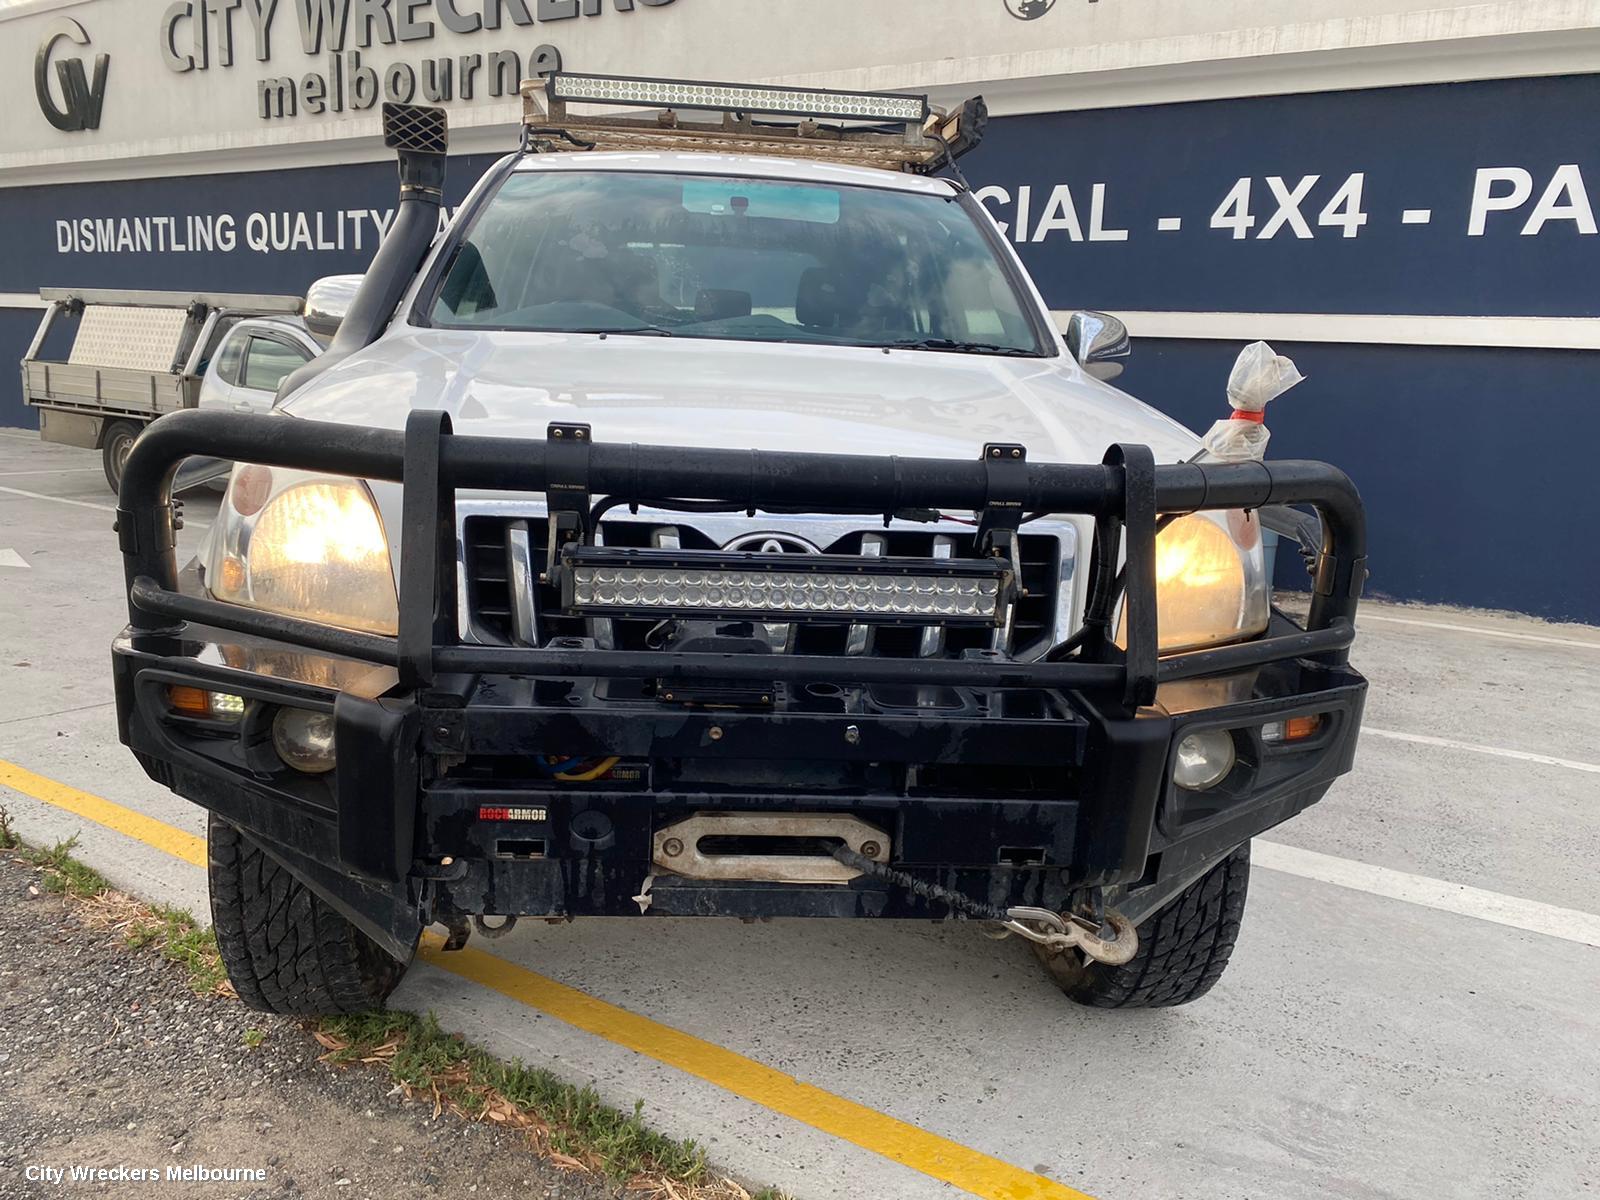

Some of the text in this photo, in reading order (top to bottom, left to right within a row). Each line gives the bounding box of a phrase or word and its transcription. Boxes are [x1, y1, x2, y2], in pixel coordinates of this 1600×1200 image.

[160, 0, 278, 72] CITY
[257, 44, 562, 119] melbourne
[56, 215, 236, 252] DISMANTLING
[246, 209, 394, 253] QUALITY
[1210, 173, 1367, 240] 4X4
